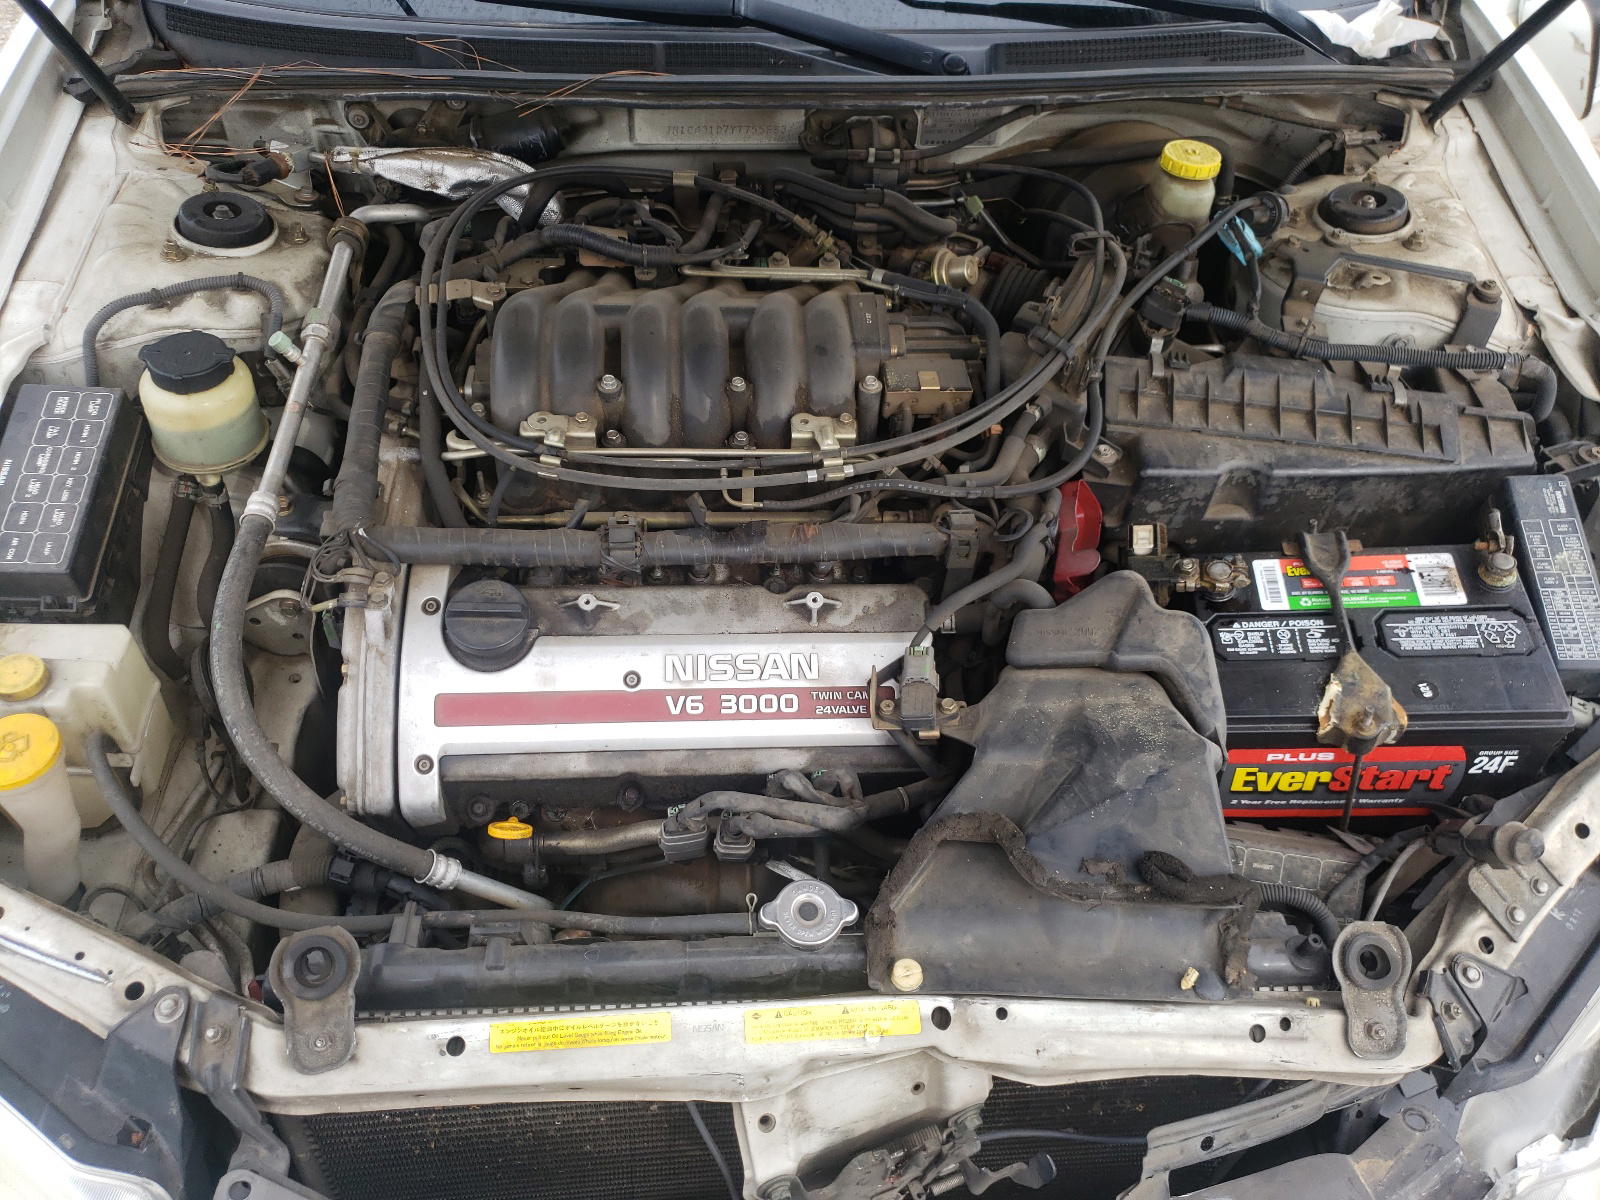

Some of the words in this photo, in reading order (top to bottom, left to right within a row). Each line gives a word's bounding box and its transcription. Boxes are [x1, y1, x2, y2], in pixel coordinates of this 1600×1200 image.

[1289, 619, 1324, 627] POISON
[664, 653, 820, 682] NISSAN
[811, 691, 842, 701] TWIN
[666, 695, 704, 715] V6
[720, 693, 799, 714] 3000
[815, 705, 867, 714] 24VALVE
[1266, 752, 1335, 762] PLUS
[1467, 755, 1519, 774] 24F
[1230, 765, 1453, 792] EverStart
